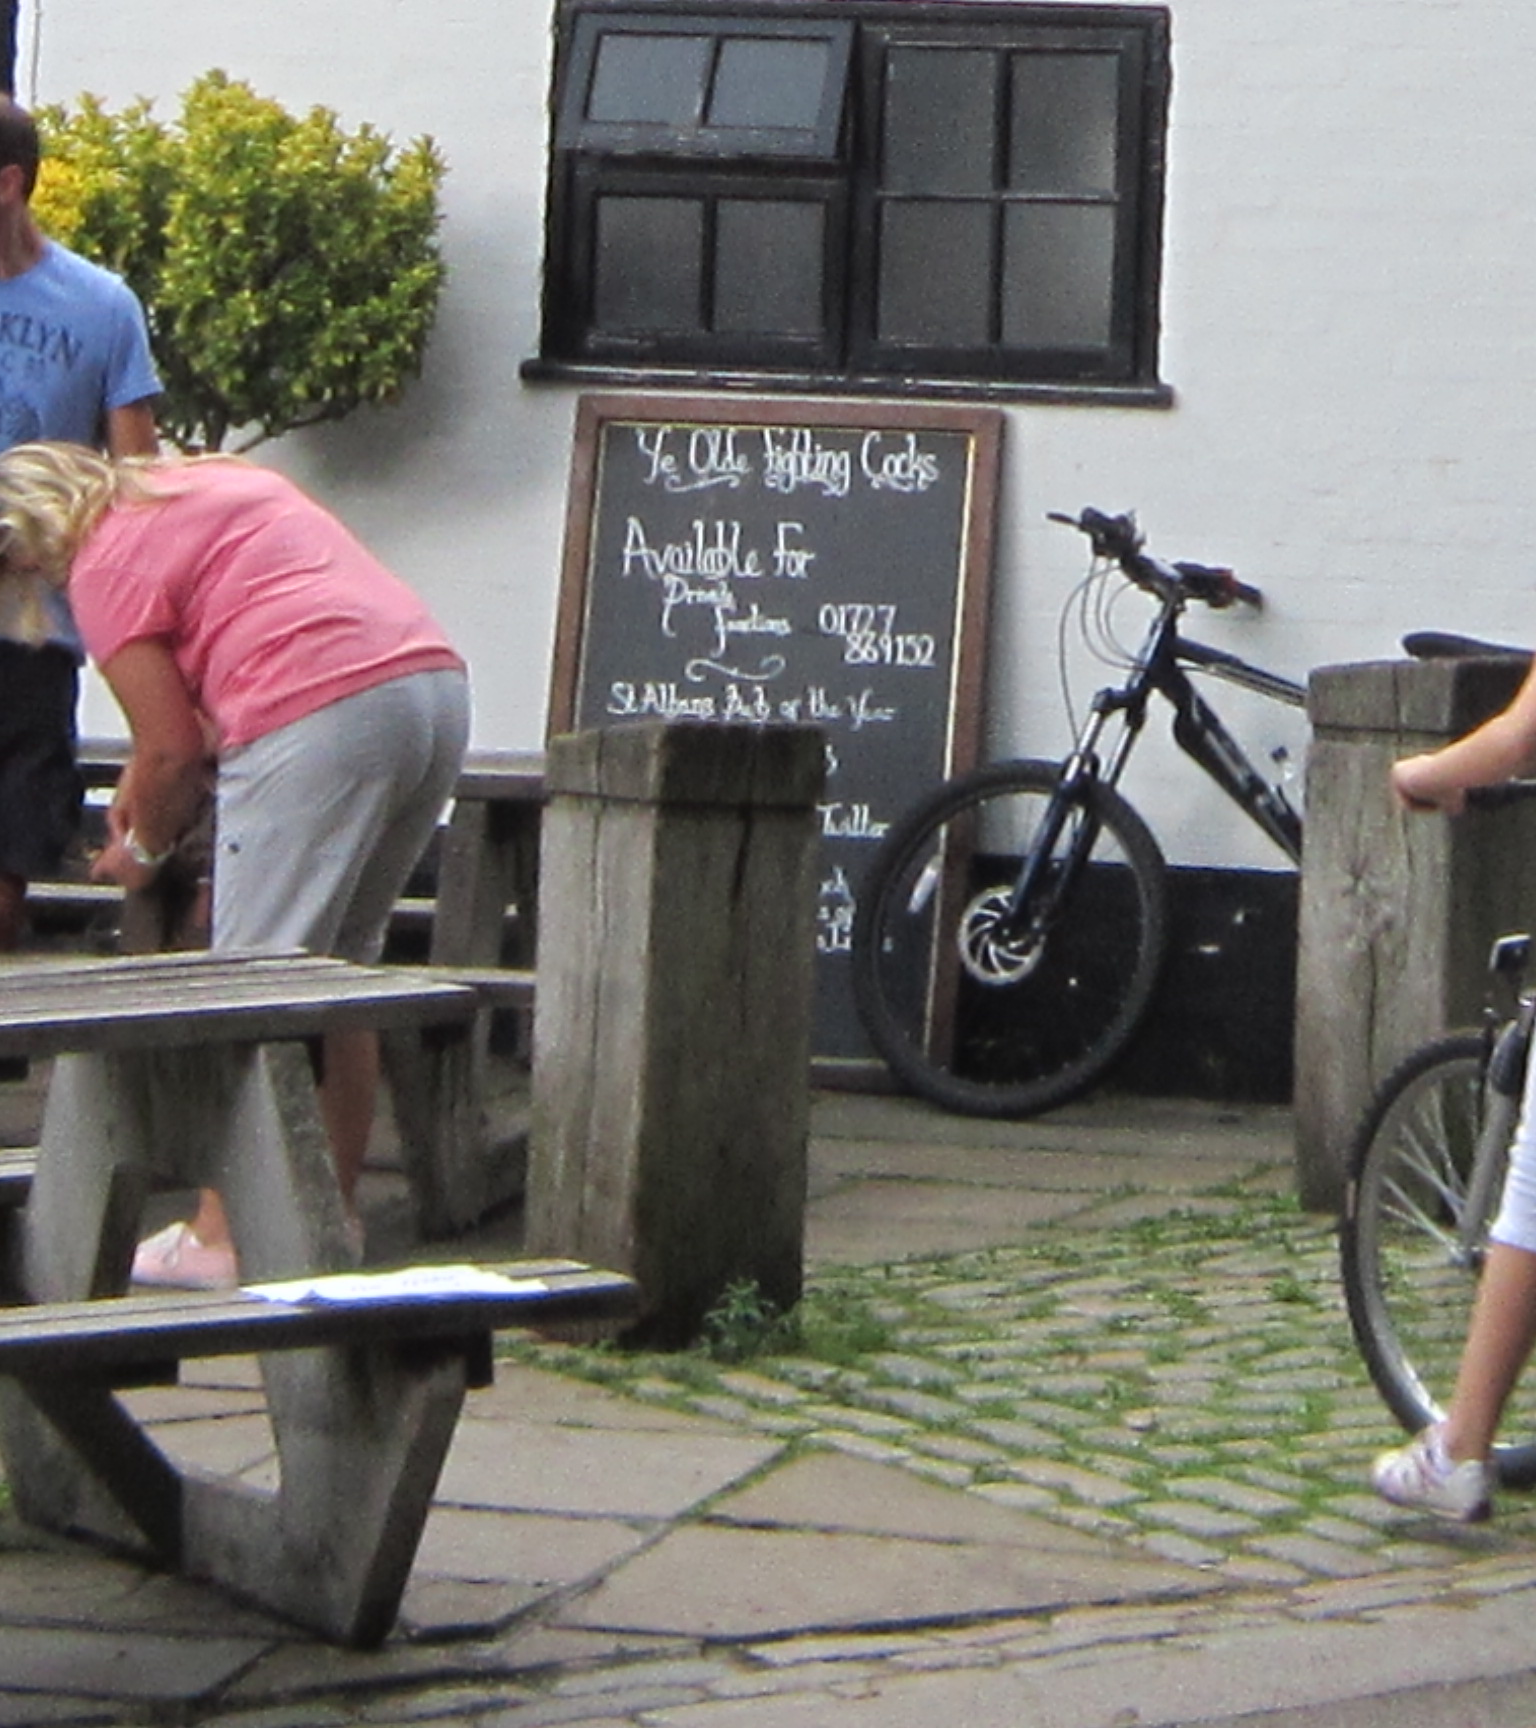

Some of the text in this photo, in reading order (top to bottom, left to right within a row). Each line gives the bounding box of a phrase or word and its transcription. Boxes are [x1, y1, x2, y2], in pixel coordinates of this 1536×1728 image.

[636, 426, 678, 484] Ye
[689, 428, 753, 475] Olde
[861, 431, 940, 490] Cocks
[623, 516, 817, 581] Available For
[818, 602, 898, 635] 01727
[640, 682, 715, 719] Albans
[806, 686, 843, 718] the
